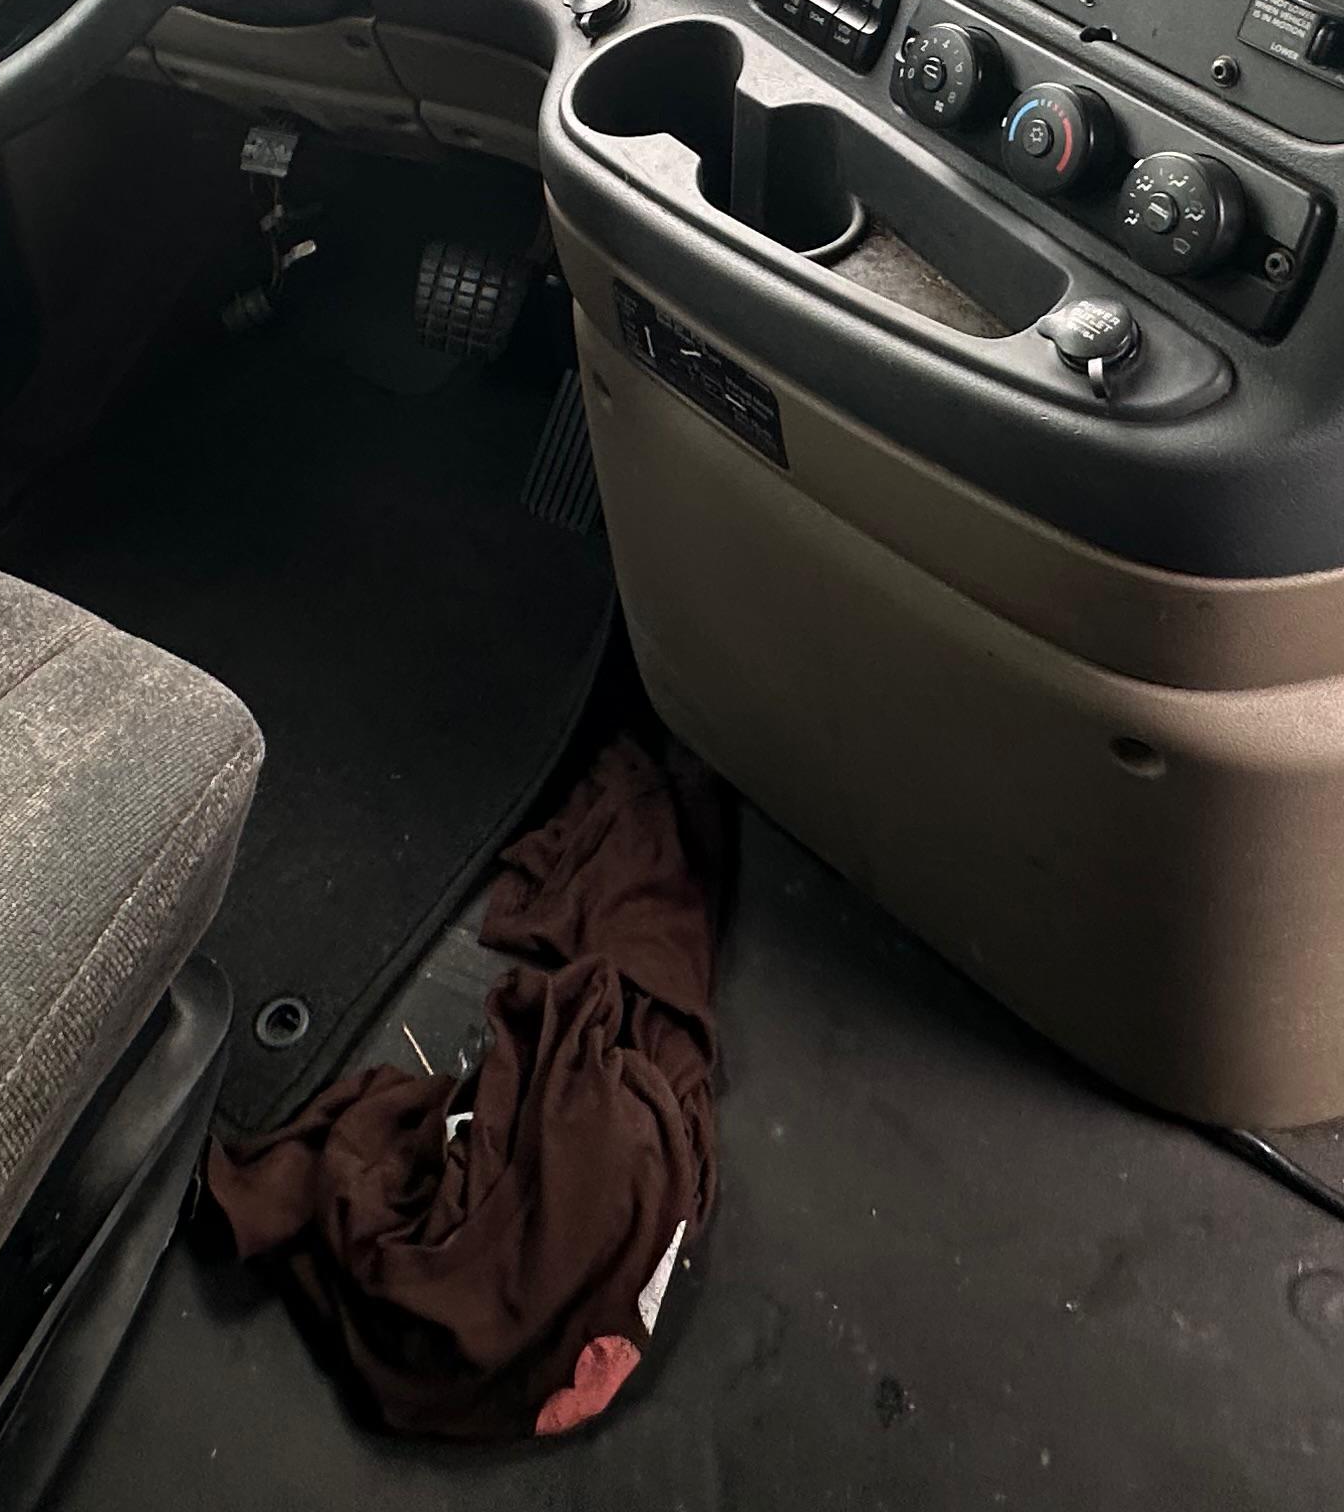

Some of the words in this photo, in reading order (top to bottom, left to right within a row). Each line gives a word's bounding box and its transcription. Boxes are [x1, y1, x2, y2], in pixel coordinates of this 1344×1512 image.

[920, 39, 929, 52] 2
[942, 39, 950, 49] 4
[1270, 42, 1299, 60] LOWER
[955, 61, 963, 72] 6
[948, 91, 956, 103] 8
